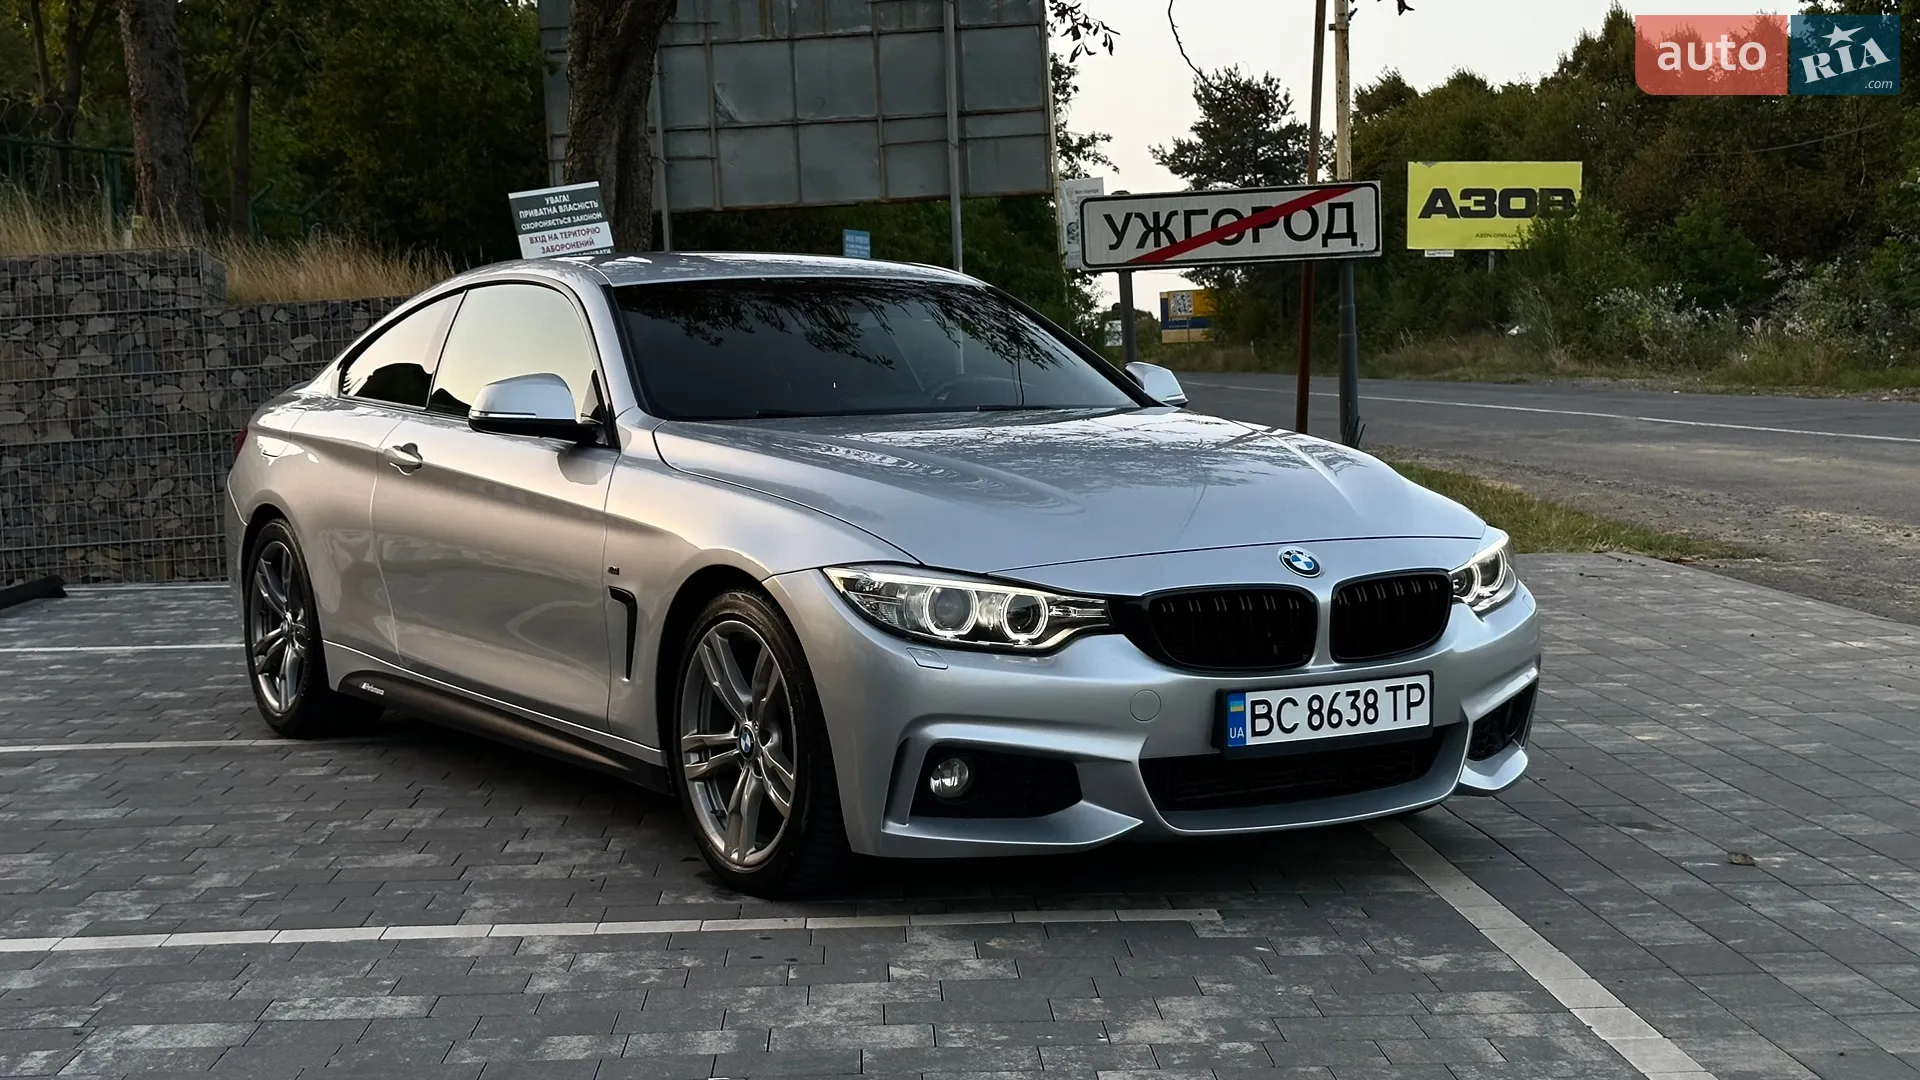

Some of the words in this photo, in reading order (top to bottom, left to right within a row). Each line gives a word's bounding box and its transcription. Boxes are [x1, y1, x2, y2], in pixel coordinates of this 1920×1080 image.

[544, 194, 570, 205] УВАГА!
[1418, 187, 1578, 219] АЗОВ
[519, 206, 558, 219] ПРИВАТНА
[558, 200, 599, 213] ВЛАСНІСТЬ
[521, 218, 572, 231] ОХОРОНЯЄТЬСЯ
[572, 212, 603, 223] ЗАКОНОМ
[1103, 201, 1358, 250] УЖГОРОД
[529, 234, 547, 245] ВХІД
[548, 233, 559, 242] НА
[560, 226, 601, 240] ТЕРИТОРІЮ
[541, 237, 595, 254] ЗАБОРОНЕНИЙ
[1250, 696, 1299, 737] BC
[1307, 688, 1379, 731] 8638
[1385, 682, 1425, 722] TP
[1229, 727, 1244, 739] UA
